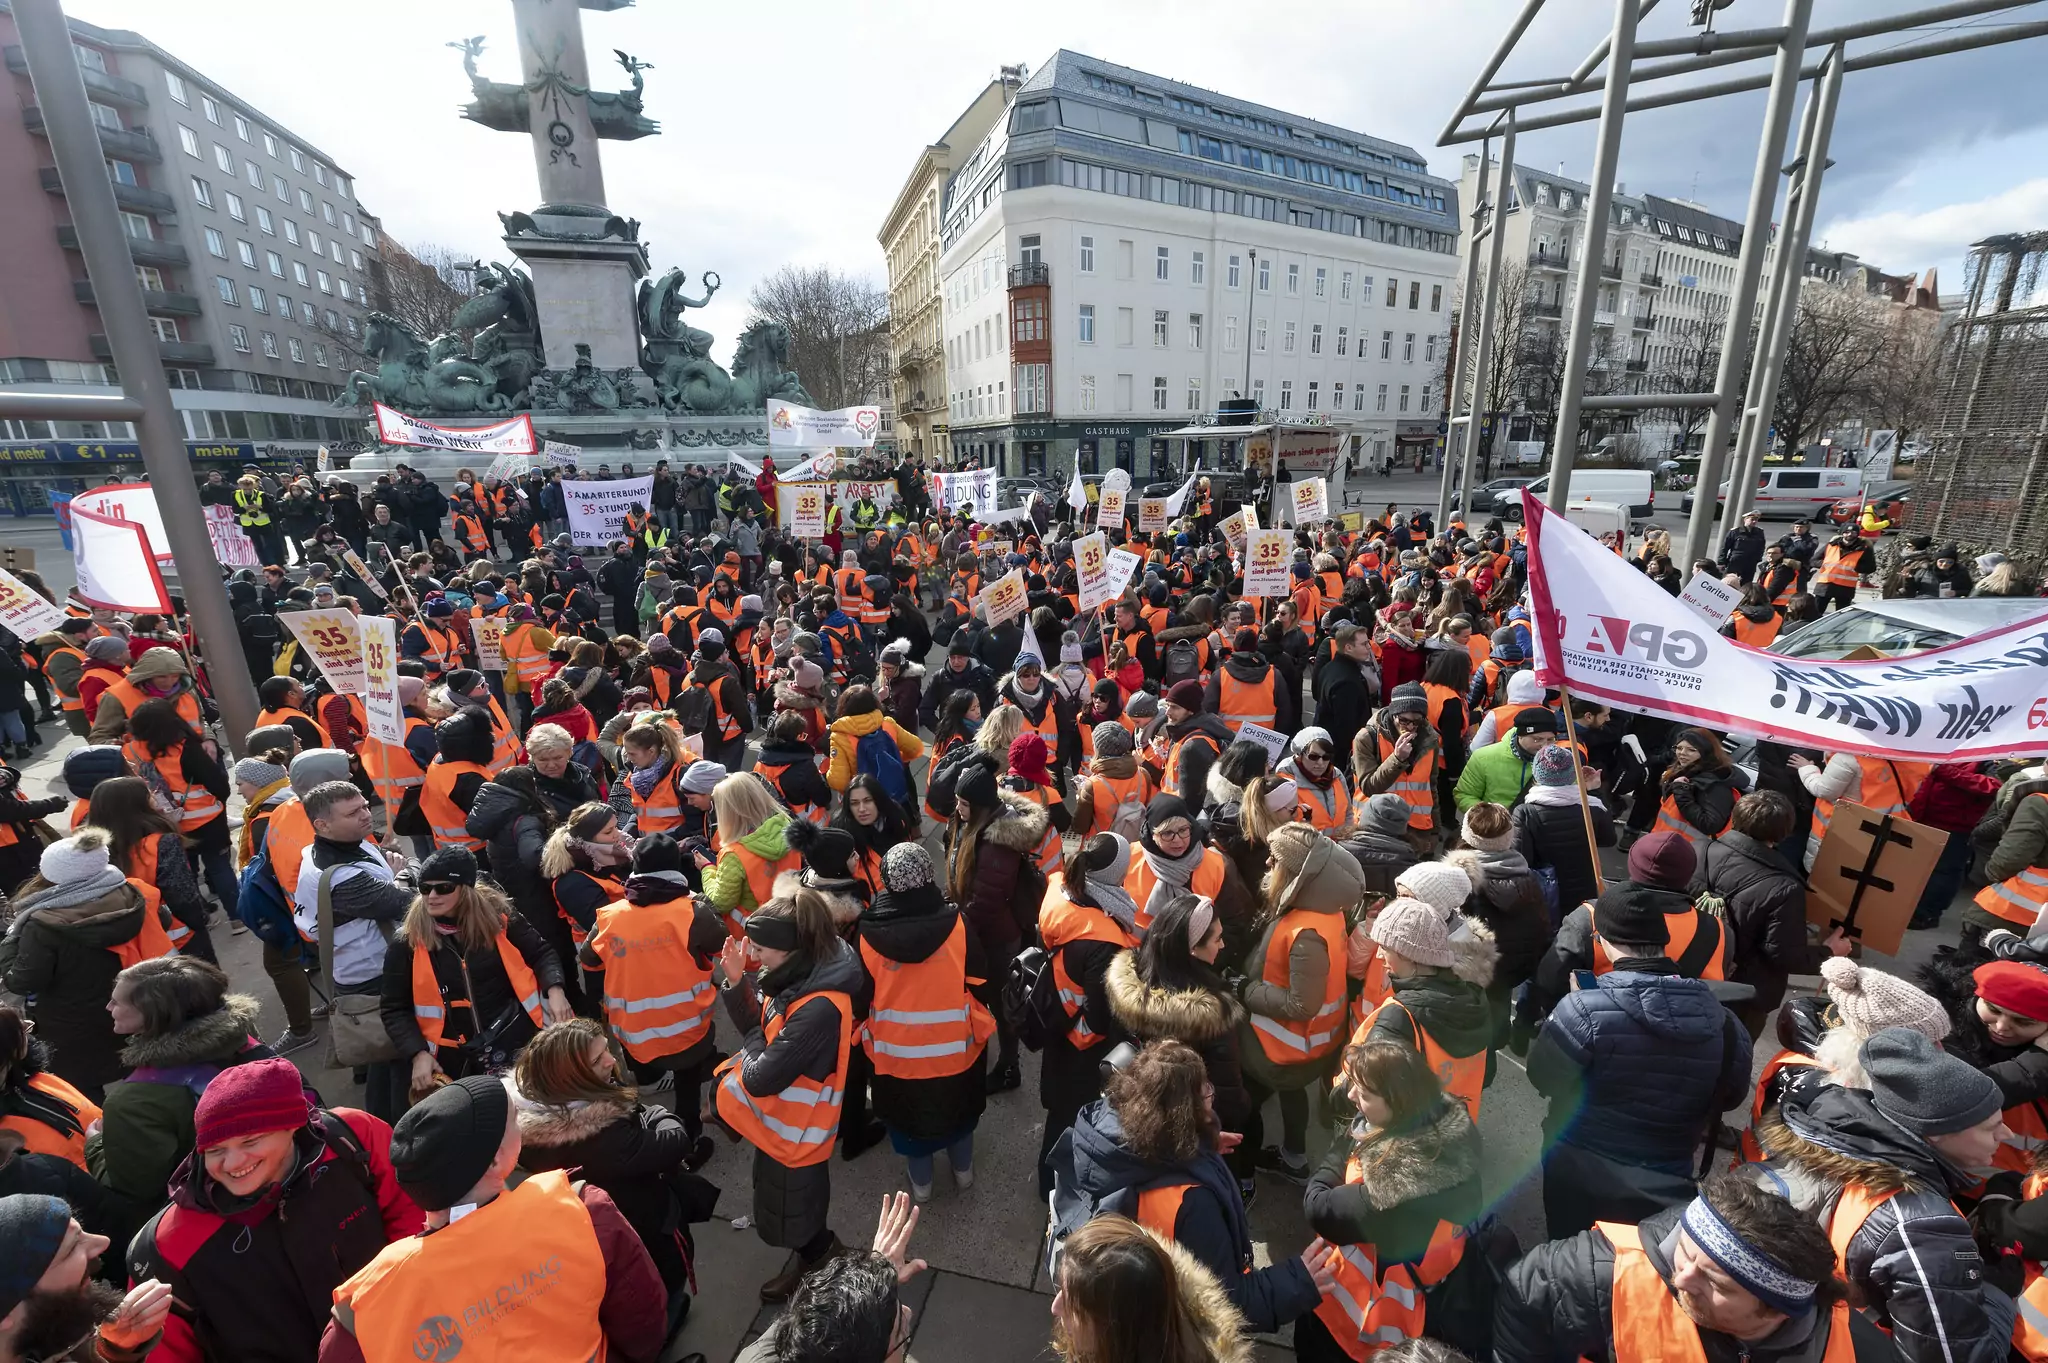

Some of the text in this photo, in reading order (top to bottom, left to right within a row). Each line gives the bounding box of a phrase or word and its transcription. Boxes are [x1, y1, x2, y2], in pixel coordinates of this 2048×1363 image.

[793, 421, 819, 429] Förderung
[1085, 427, 1131, 435] GASTHAUS
[384, 427, 409, 441] vida
[418, 434, 444, 446] mehr
[445, 436, 484, 450] WERT!
[14, 448, 47, 461] mehr
[76, 445, 90, 459] €
[93, 445, 107, 459] 1
[195, 445, 240, 457] mehr
[1250, 448, 1266, 461] 35
[1267, 449, 1296, 459] Snden
[1299, 446, 1314, 456] sind
[550, 454, 576, 464] Streiken
[1868, 456, 1888, 466] Zone
[567, 487, 650, 500] SAMARITERBUND!
[945, 483, 991, 504] BILDUNG
[1299, 487, 1313, 499] 35
[801, 498, 816, 508] 35
[1107, 497, 1119, 506] 35
[582, 504, 595, 515] 35
[1246, 513, 1254, 522] 35
[208, 520, 240, 539] DEMIE
[1229, 521, 1241, 532] 35
[573, 531, 625, 540] DER KOMP
[996, 547, 1007, 556] 35
[1085, 547, 1099, 566] 35
[1260, 542, 1280, 558] 35
[1113, 552, 1133, 563] Caritas
[1082, 566, 1100, 578] Stunden
[1120, 567, 1130, 576] 38
[1267, 566, 1287, 575] genug!
[1083, 569, 1107, 586] sind genug!
[1110, 574, 1122, 584] itas
[995, 584, 1014, 601] 35
[1700, 580, 1730, 602] Caritas
[0, 598, 23, 614] tunden
[6, 598, 43, 620] sind genug!
[990, 596, 1013, 610] Stunden
[993, 592, 1022, 615] sind genug!
[1682, 593, 1697, 605] Mut
[1702, 604, 1724, 620] Angst
[312, 626, 348, 648] 35
[483, 628, 500, 641] 35
[315, 648, 352, 659] Stunden
[369, 643, 384, 670] 35
[324, 659, 344, 669] sind
[367, 672, 383, 685] tunden
[376, 689, 393, 704] genug!
[1242, 726, 1284, 746] ICH STREIKE!
[463, 1255, 562, 1327] BILDUNG
